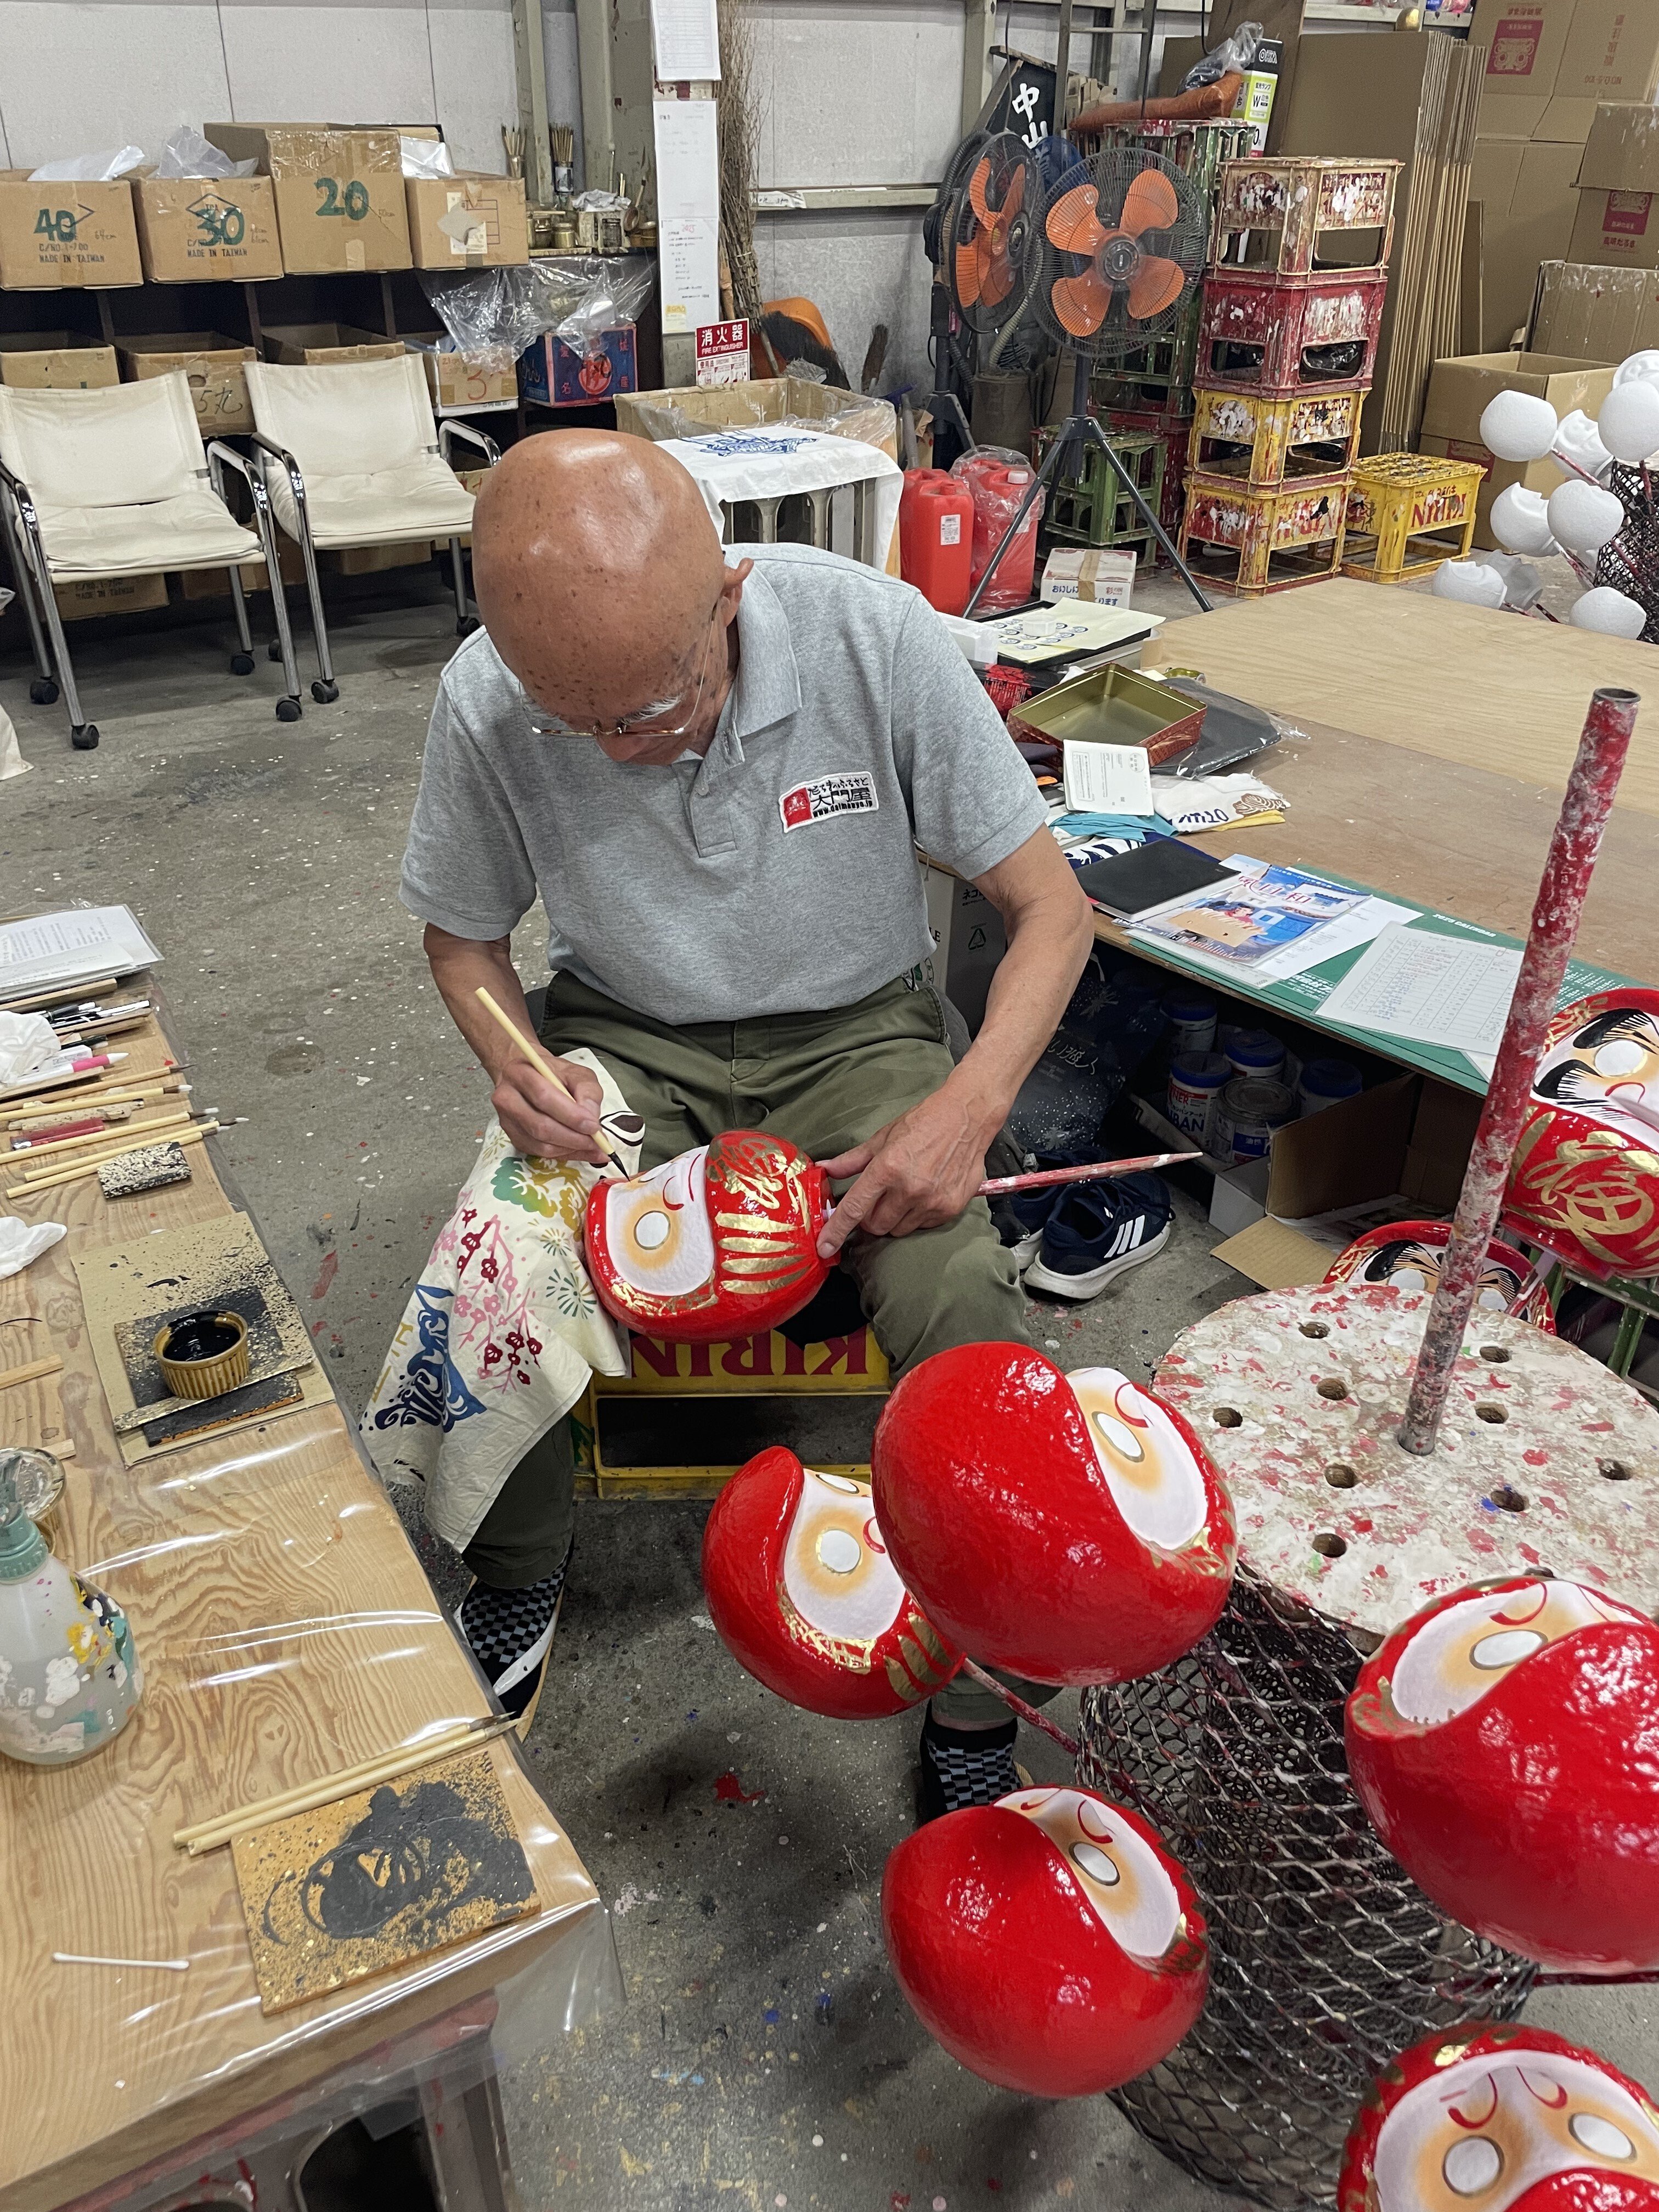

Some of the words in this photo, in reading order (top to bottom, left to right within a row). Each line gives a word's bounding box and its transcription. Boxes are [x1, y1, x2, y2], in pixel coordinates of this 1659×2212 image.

[1253, 94, 1261, 108] W
[314, 177, 369, 221] 20
[33, 208, 77, 242] 40
[195, 207, 245, 246] 30
[40, 254, 59, 263] MADE
[63, 254, 71, 263] IN
[77, 254, 105, 263] TAIWAN
[187, 249, 205, 258] MADE
[209, 249, 217, 257] IN
[222, 249, 247, 257] TAIWAN
[701, 324, 743, 347] 消火器
[713, 341, 743, 353] EXTINGUISHER
[810, 787, 872, 810] 大門屋
[1454, 921, 1497, 937] CALENDAR
[631, 1325, 868, 1377] KIRIN
